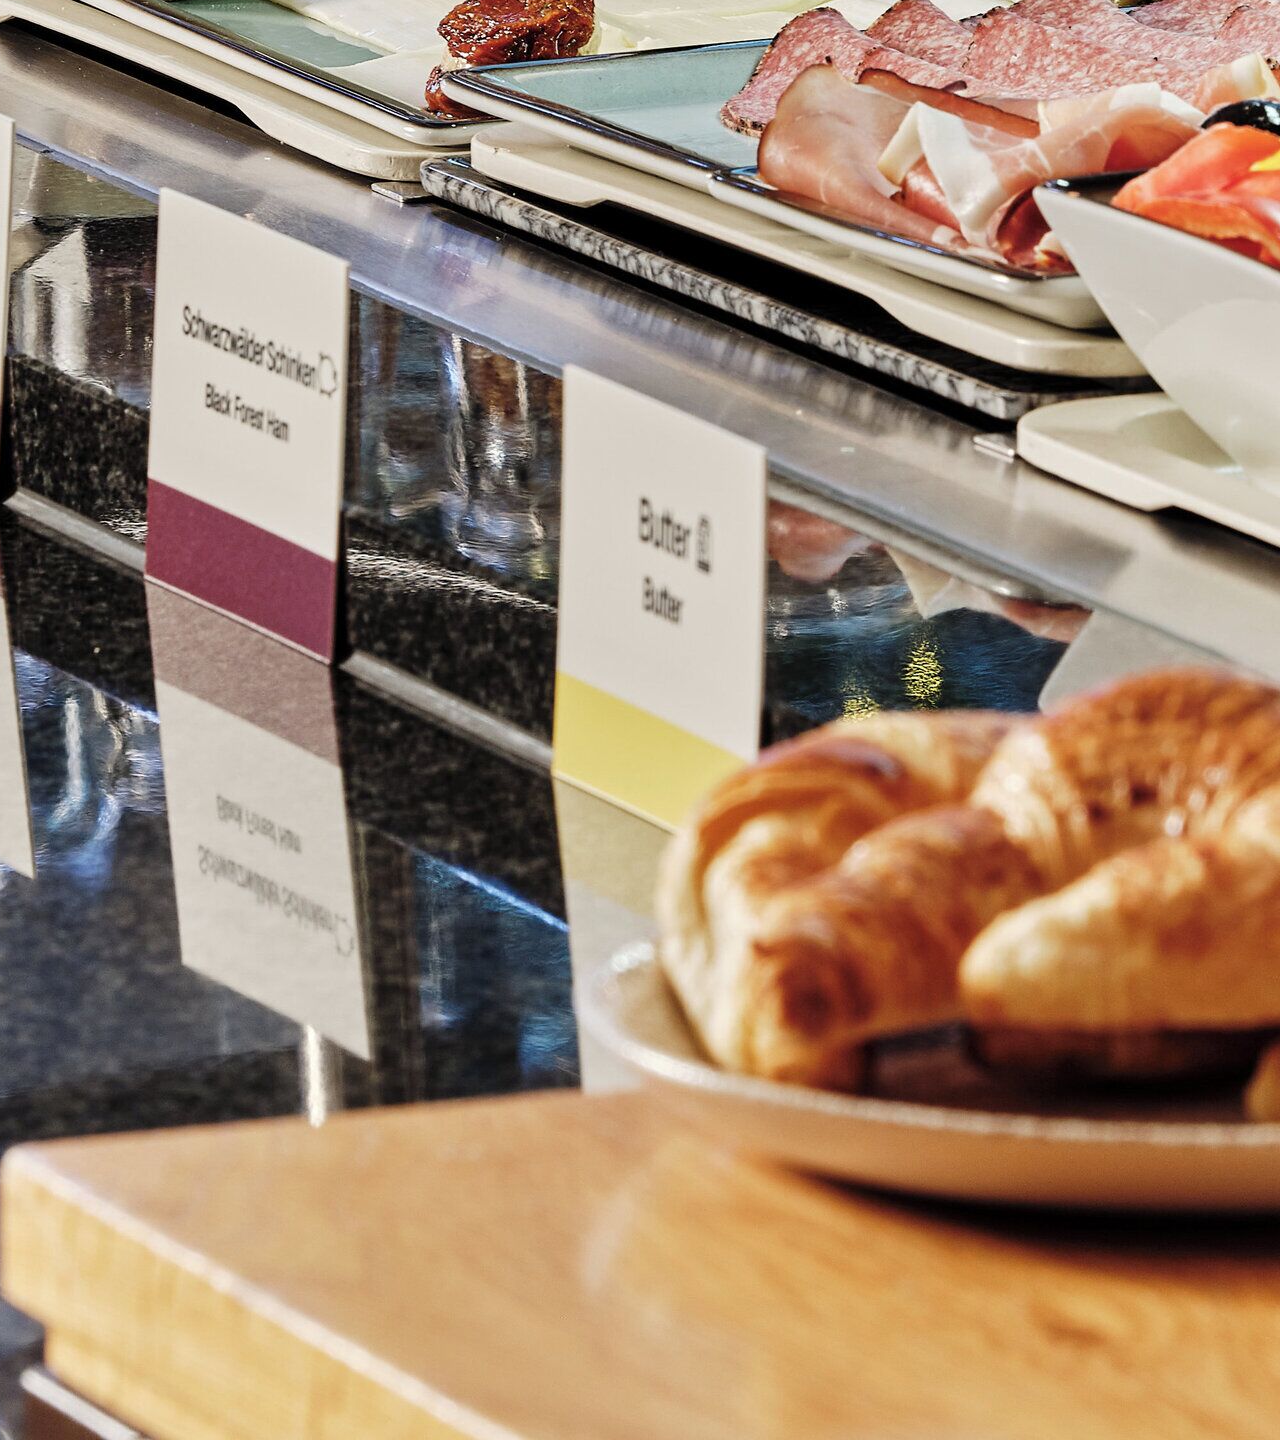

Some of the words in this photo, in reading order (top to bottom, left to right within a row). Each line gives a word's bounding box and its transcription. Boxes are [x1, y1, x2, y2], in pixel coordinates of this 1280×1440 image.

[182, 305, 266, 366] Schwarzwälder
[266, 340, 317, 389] Schinken
[205, 382, 231, 417] Black
[233, 395, 265, 431] Forest
[267, 409, 290, 442] Ham
[639, 496, 691, 559] Butter
[643, 575, 684, 626] Butter
